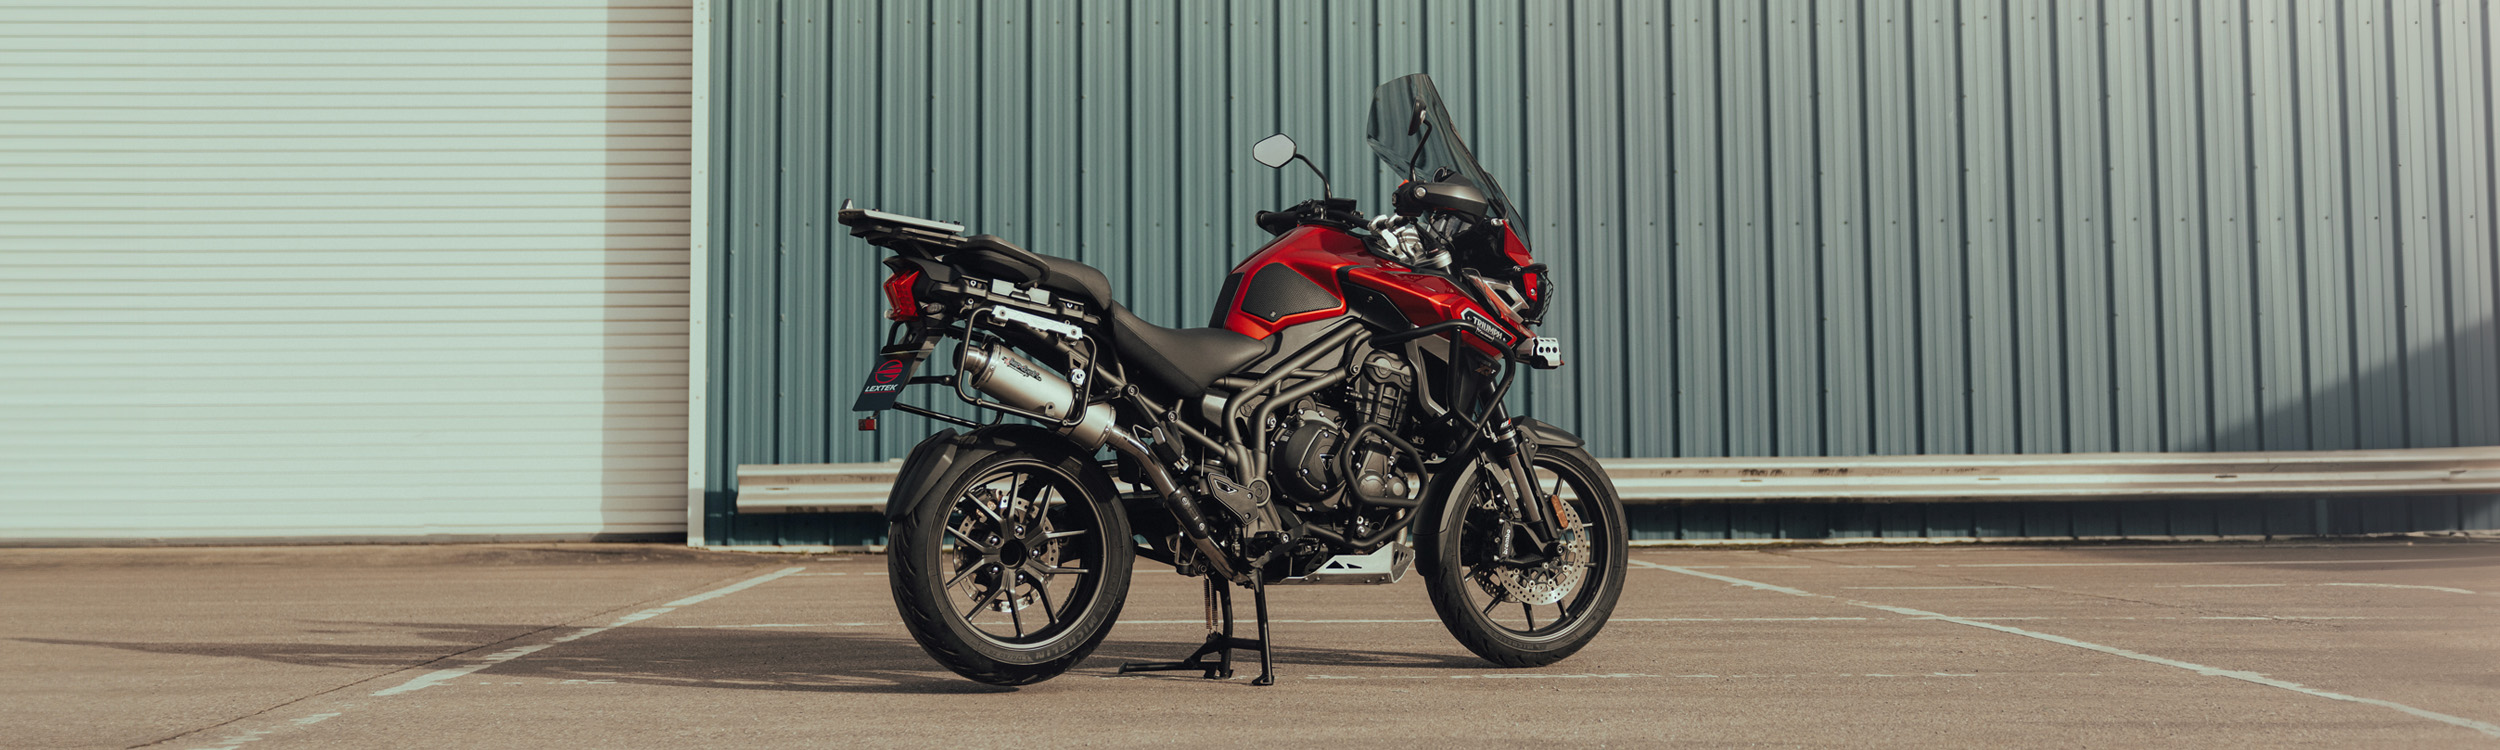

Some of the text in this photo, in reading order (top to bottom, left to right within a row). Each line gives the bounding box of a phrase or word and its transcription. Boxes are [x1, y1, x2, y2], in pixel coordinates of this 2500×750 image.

[1472, 316, 1503, 339] TRIUMPH
[865, 384, 898, 392] LEXTEK
[1503, 529, 1511, 555] brembo
[1035, 616, 1099, 660] MICHELIN
